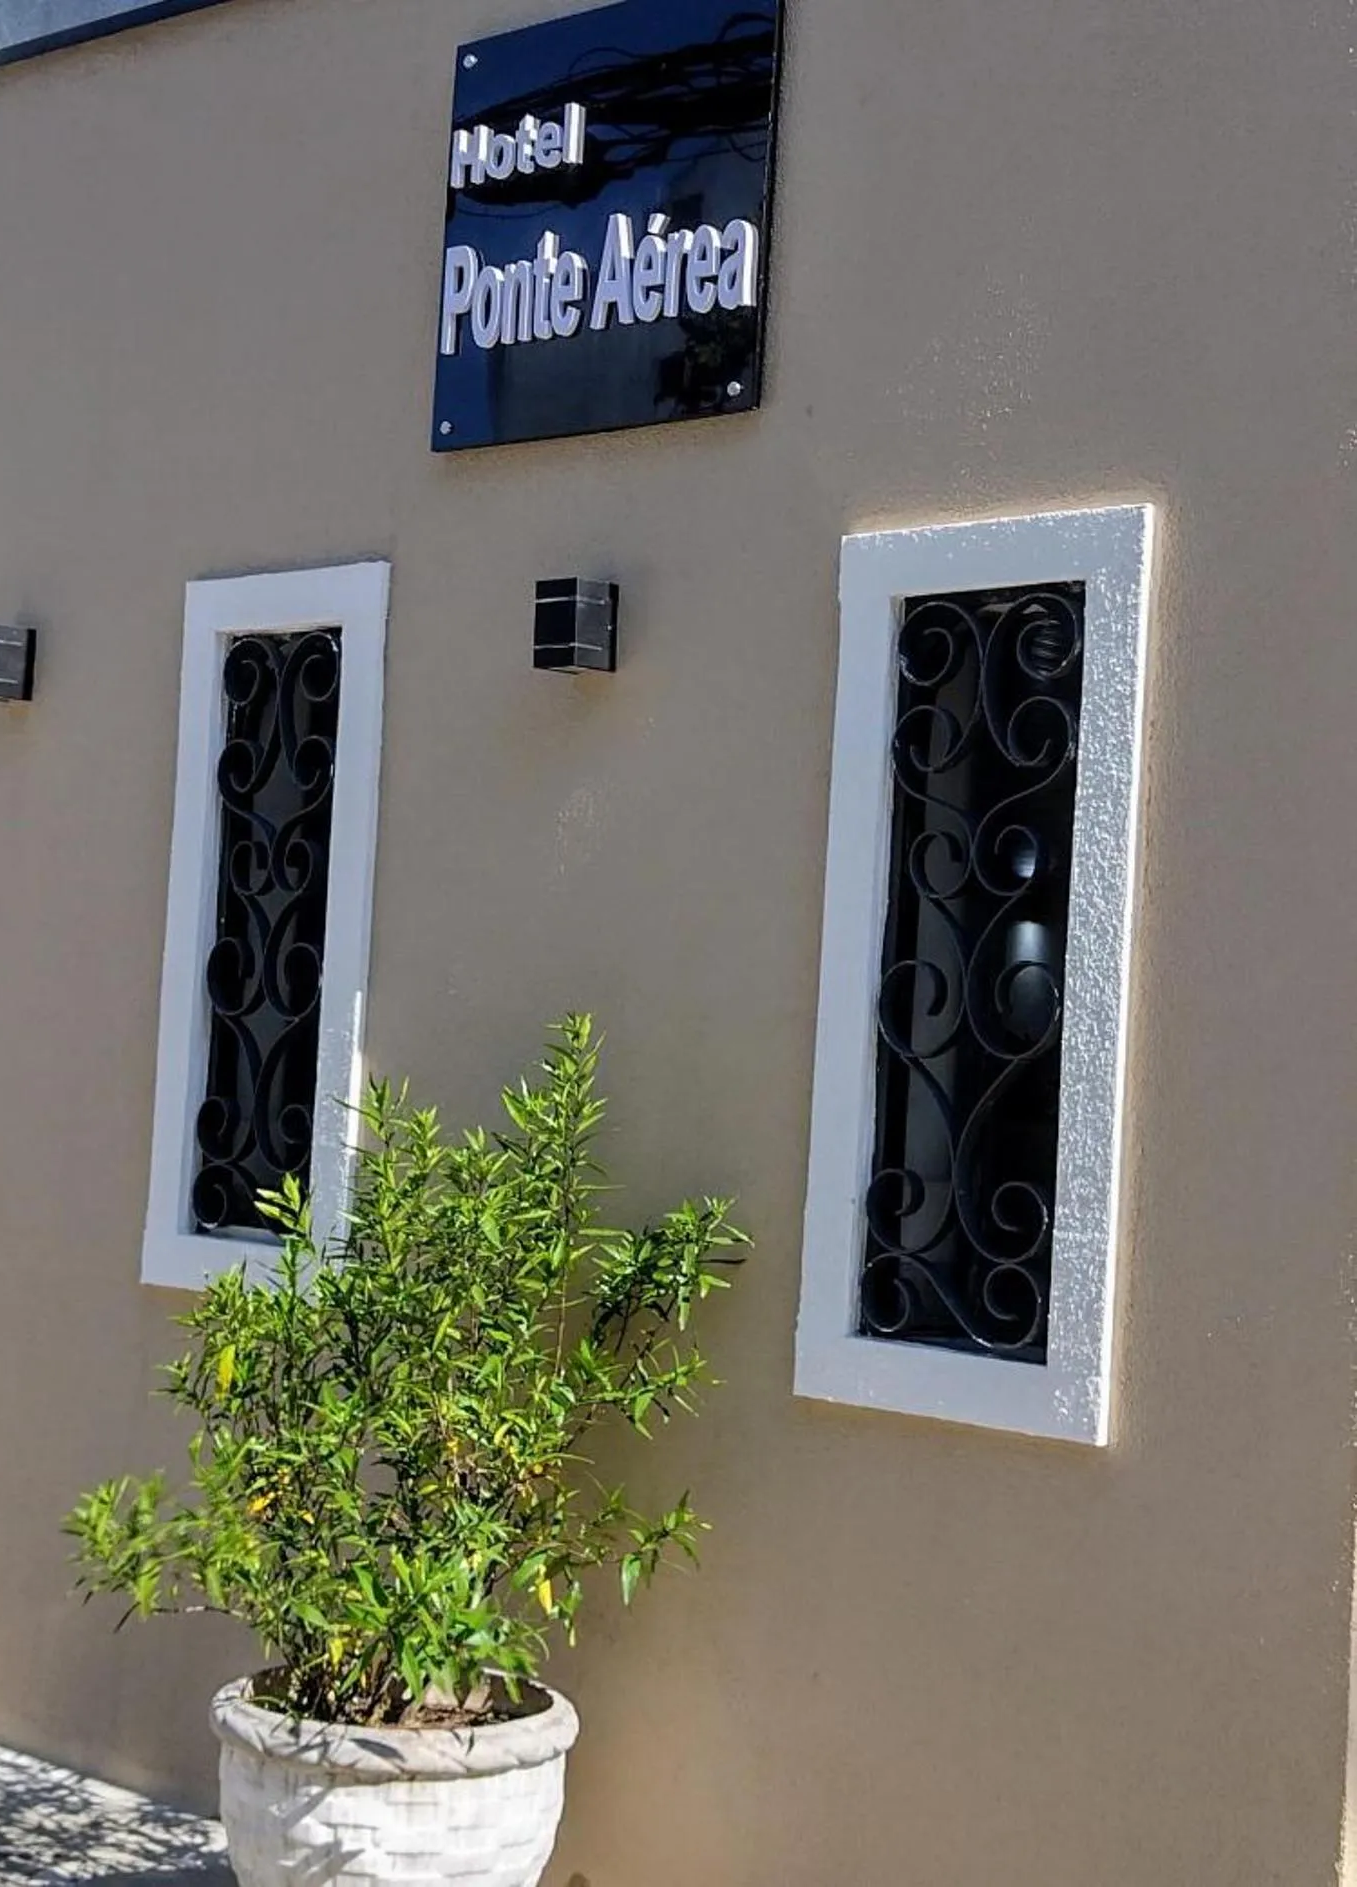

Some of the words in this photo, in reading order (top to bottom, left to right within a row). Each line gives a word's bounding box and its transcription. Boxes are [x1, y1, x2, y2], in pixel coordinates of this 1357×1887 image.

[450, 102, 586, 189] Hotel
[440, 230, 588, 355] Ponte
[589, 212, 759, 331] Aérea
